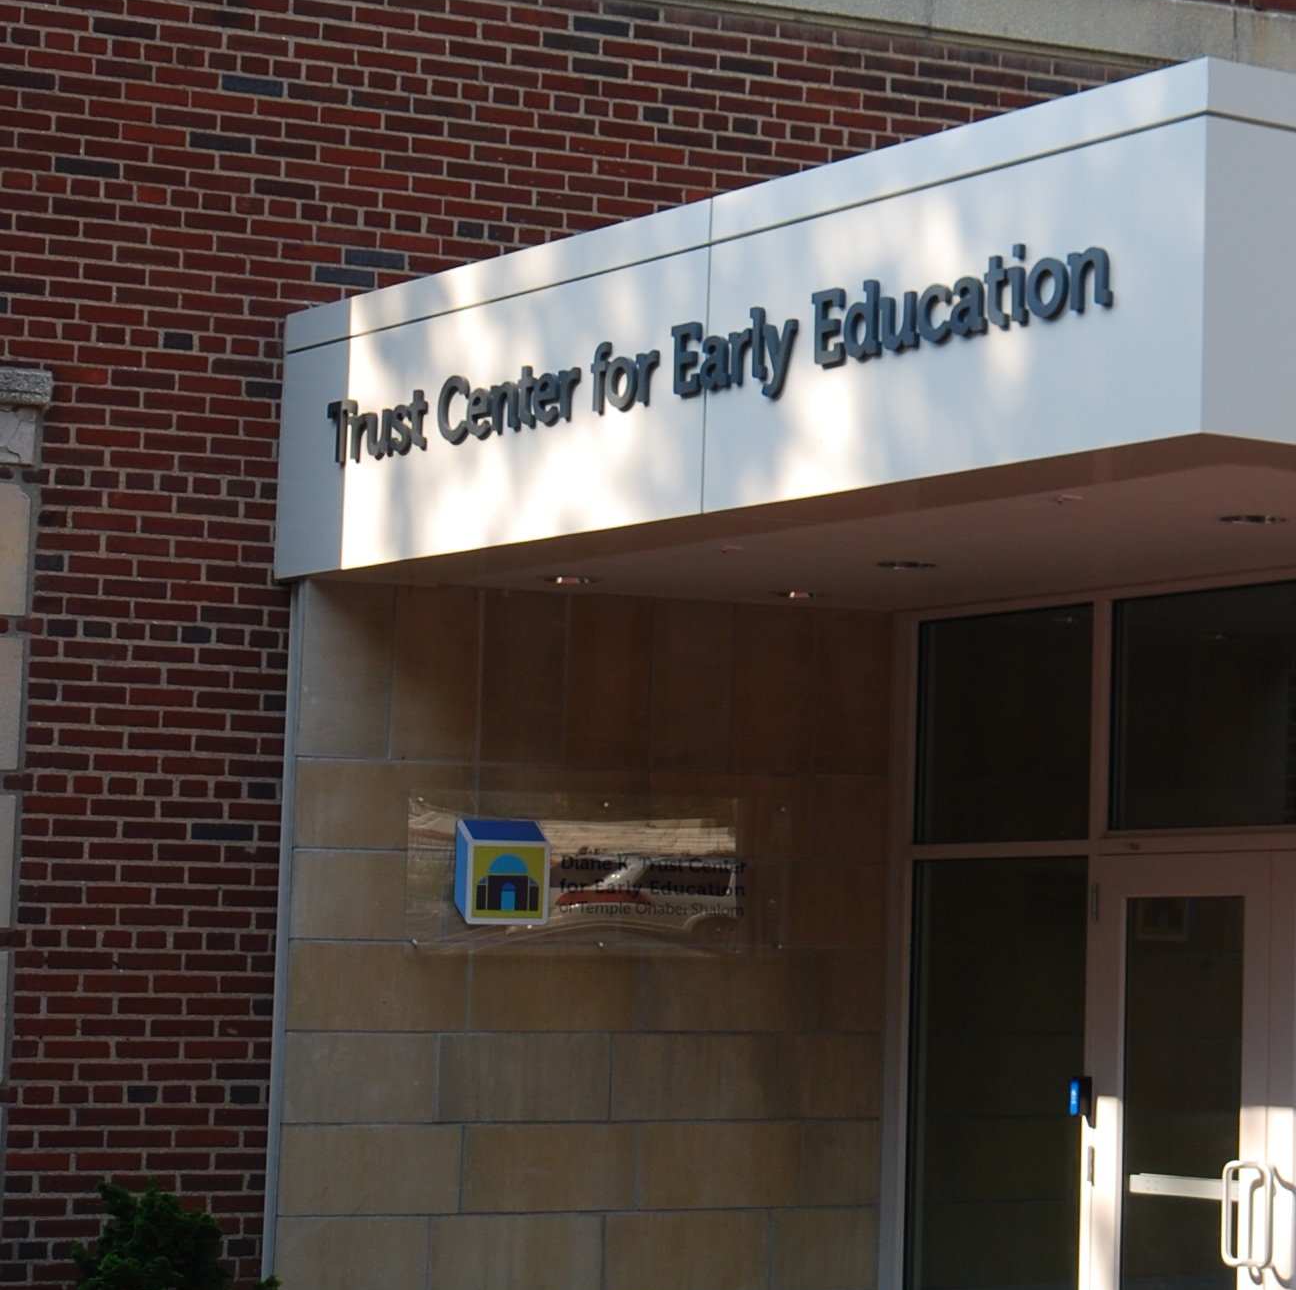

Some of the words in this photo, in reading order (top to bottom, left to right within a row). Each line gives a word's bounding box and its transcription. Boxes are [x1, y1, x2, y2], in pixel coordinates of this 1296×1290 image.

[327, 389, 428, 465] Trust
[436, 363, 582, 445] Center
[591, 341, 660, 415] for
[671, 307, 800, 401] Early
[812, 244, 1115, 368] Education
[561, 854, 612, 871] Diane
[639, 857, 684, 873] Trust
[688, 858, 748, 874] Center
[560, 878, 590, 894] for
[594, 880, 643, 897] Early
[650, 880, 746, 897] Education
[579, 902, 631, 916] Temple
[691, 903, 745, 917] Shalom
